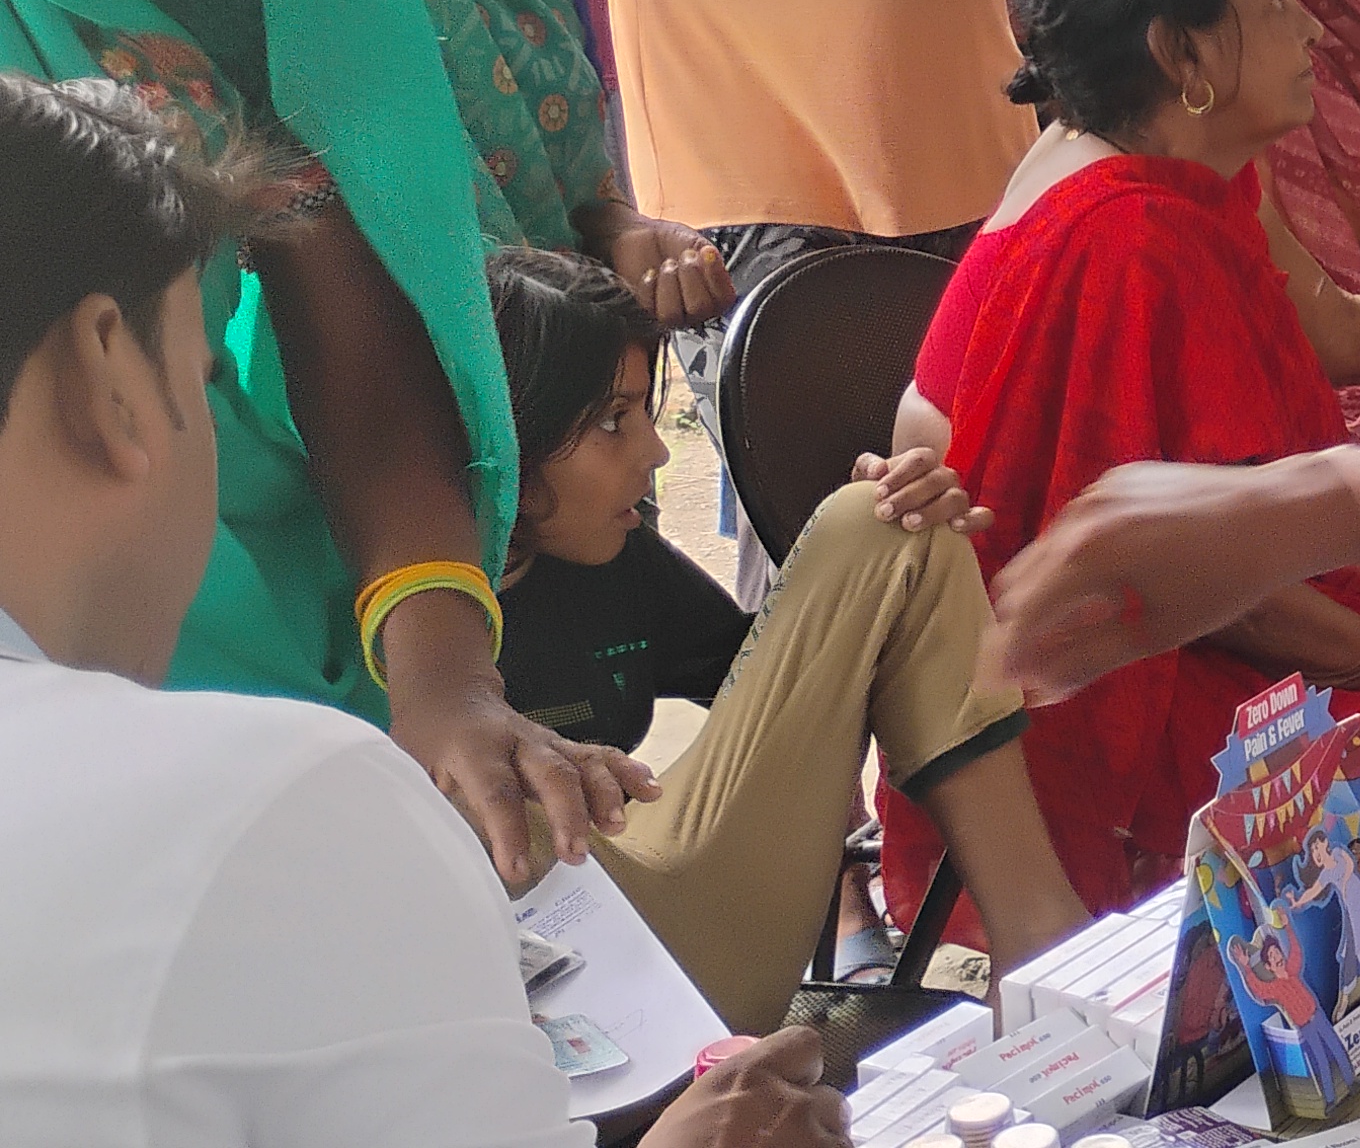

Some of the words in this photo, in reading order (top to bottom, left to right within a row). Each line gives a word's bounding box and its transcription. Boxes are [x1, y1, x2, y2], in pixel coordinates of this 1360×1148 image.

[1245, 700, 1269, 729] Zero
[1270, 683, 1298, 715] Down
[1244, 732, 1268, 761] Pain
[1268, 725, 1277, 747] &
[1277, 709, 1305, 741] Fever
[999, 1035, 1038, 1062] Pacimol
[1041, 1052, 1080, 1078] Pacimol
[1063, 1078, 1100, 1105] Pacimol
